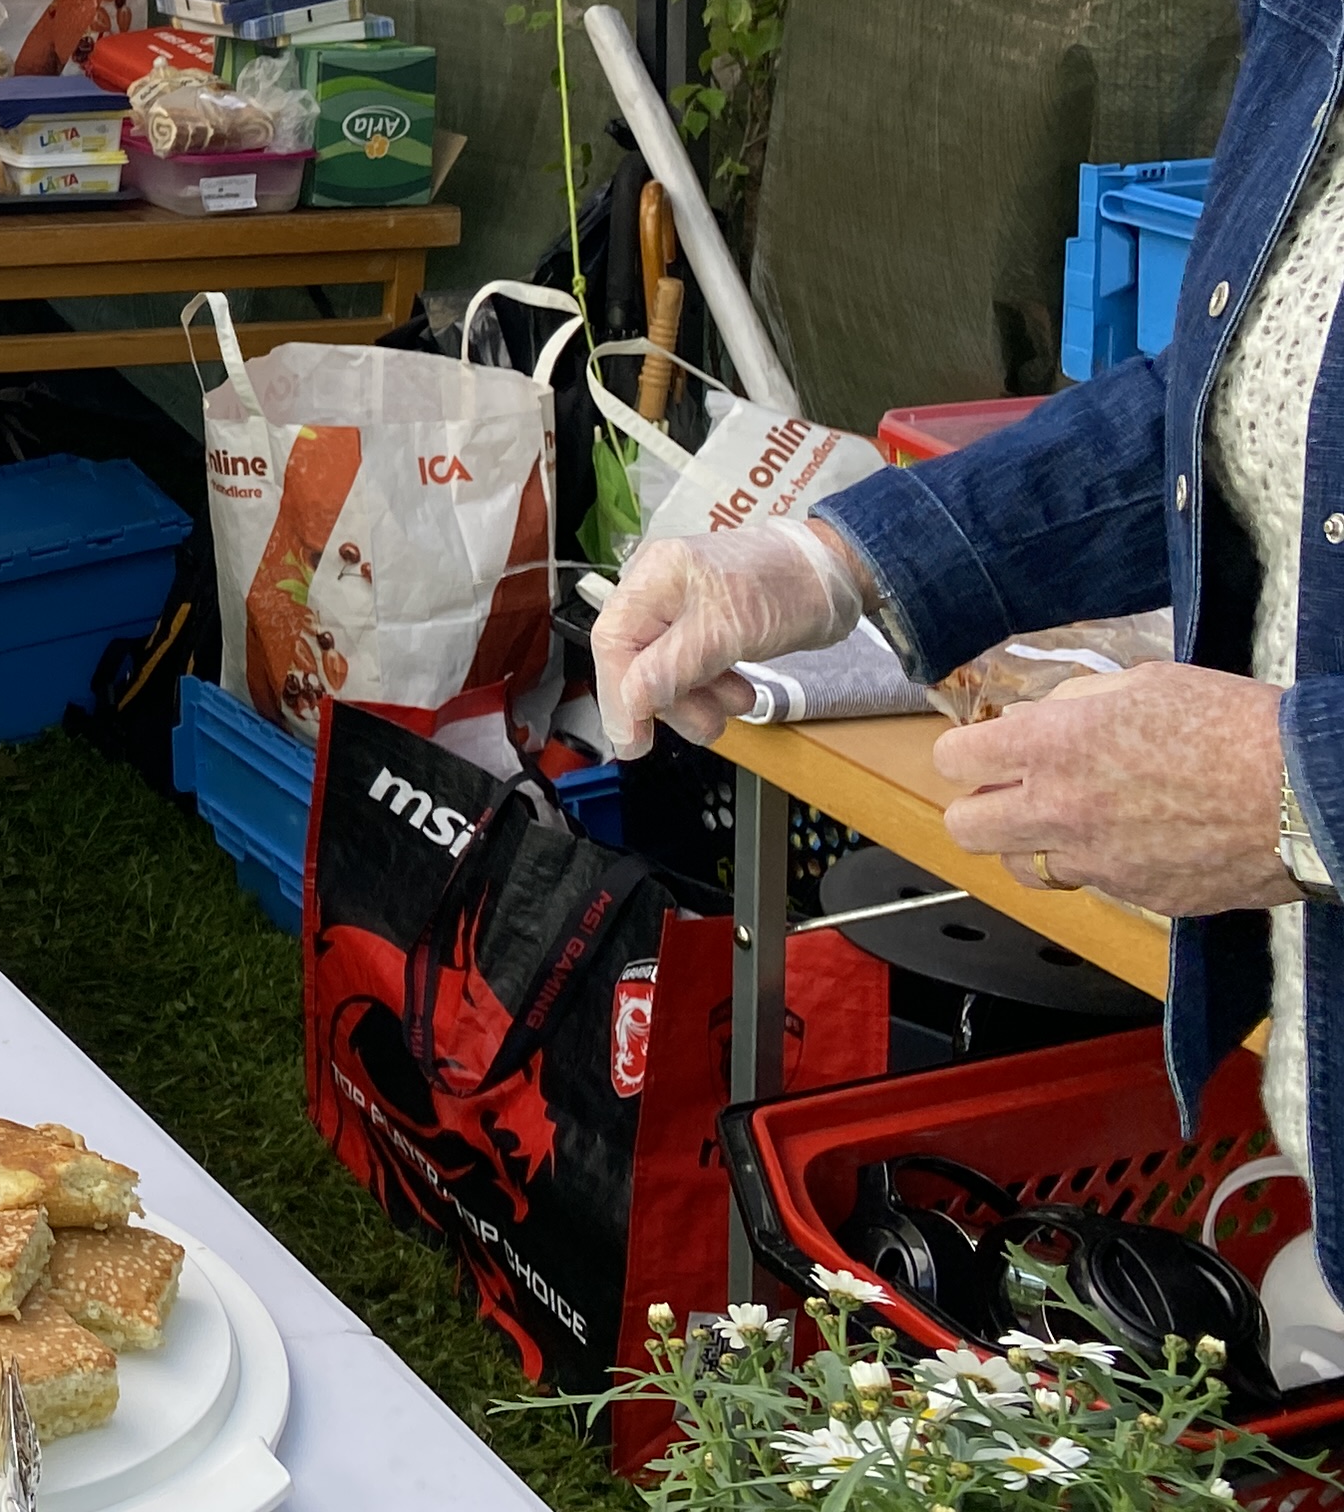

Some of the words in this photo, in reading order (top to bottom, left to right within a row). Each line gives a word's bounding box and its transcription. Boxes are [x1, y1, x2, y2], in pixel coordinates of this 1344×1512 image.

[39, 126, 81, 148] LÄTTA
[353, 116, 401, 139] Arla
[38, 172, 79, 195] LÄTTA
[208, 449, 268, 476] nline
[417, 454, 474, 486] ICA
[708, 487, 759, 533] dla
[749, 418, 812, 488] onlin
[368, 766, 476, 859] msi
[578, 889, 614, 936] MSI
[525, 937, 587, 1030] GAMING
[331, 1059, 366, 1109] TOP
[451, 1194, 499, 1244] TOP
[503, 1238, 587, 1346] CHOICE
